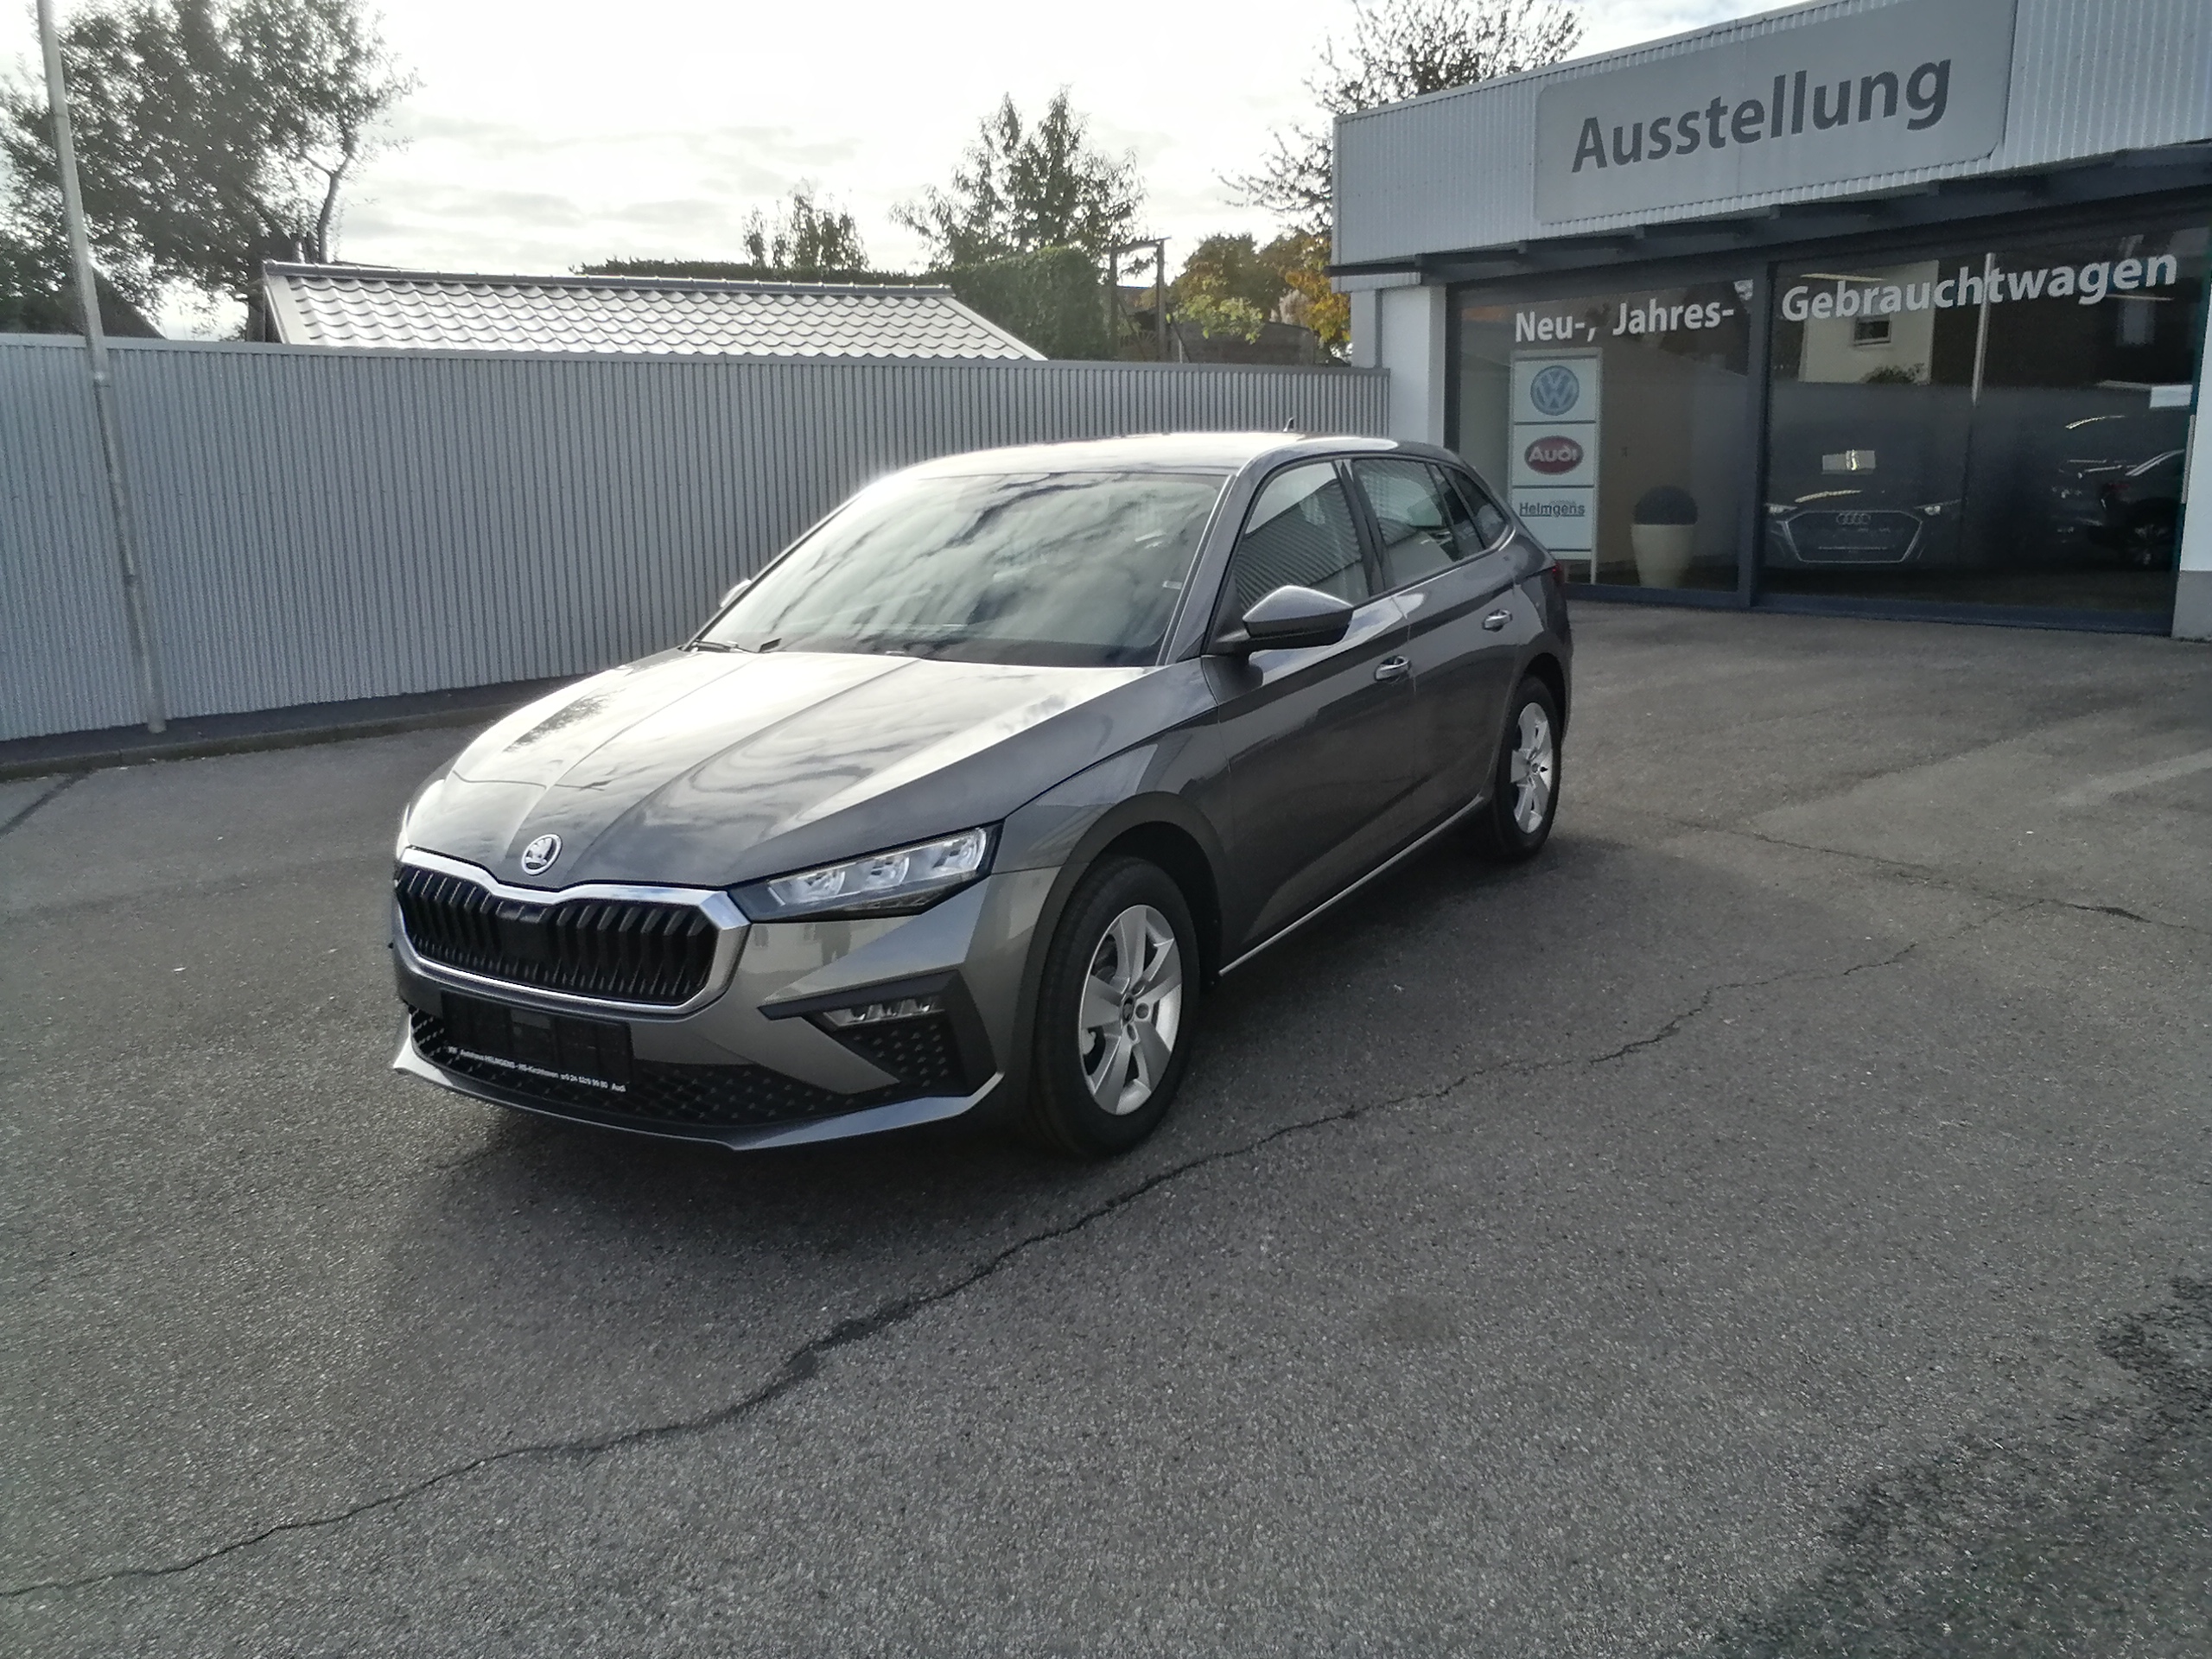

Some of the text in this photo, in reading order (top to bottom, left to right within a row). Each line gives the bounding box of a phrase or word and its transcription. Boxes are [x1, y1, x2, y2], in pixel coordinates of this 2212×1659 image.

[1572, 59, 1951, 172] Ausstellung
[1516, 253, 2177, 343] Neu-, Jahres- Gebrauchtwagen
[1529, 446, 1579, 462] Audi
